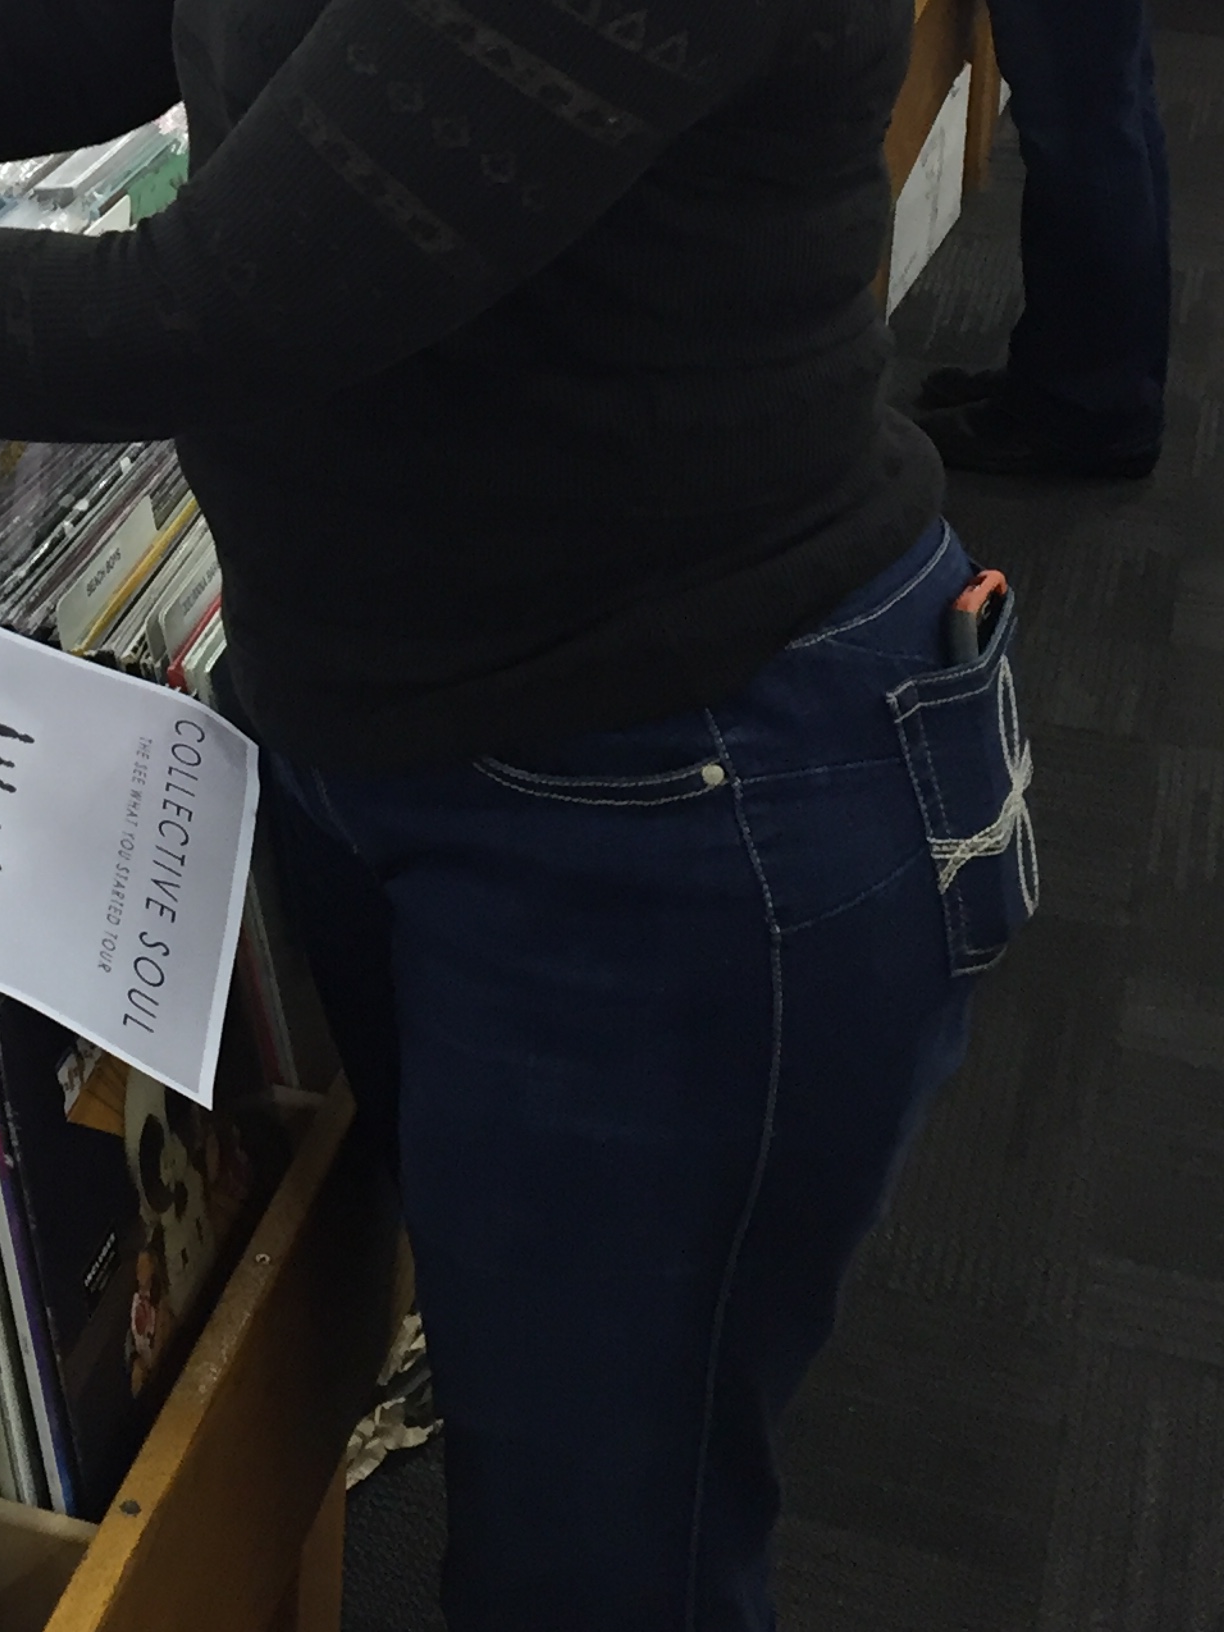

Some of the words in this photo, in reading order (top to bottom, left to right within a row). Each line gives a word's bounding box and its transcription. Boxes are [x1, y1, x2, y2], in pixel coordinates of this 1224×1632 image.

[139, 736, 153, 762] THE
[130, 762, 148, 787] SEE
[126, 790, 143, 828] WHAT
[144, 719, 206, 925] COLLECTIVE
[117, 830, 135, 864] YOU
[106, 863, 131, 927] STARTED
[97, 931, 119, 974] TOUR
[122, 930, 171, 1034] SOUL
